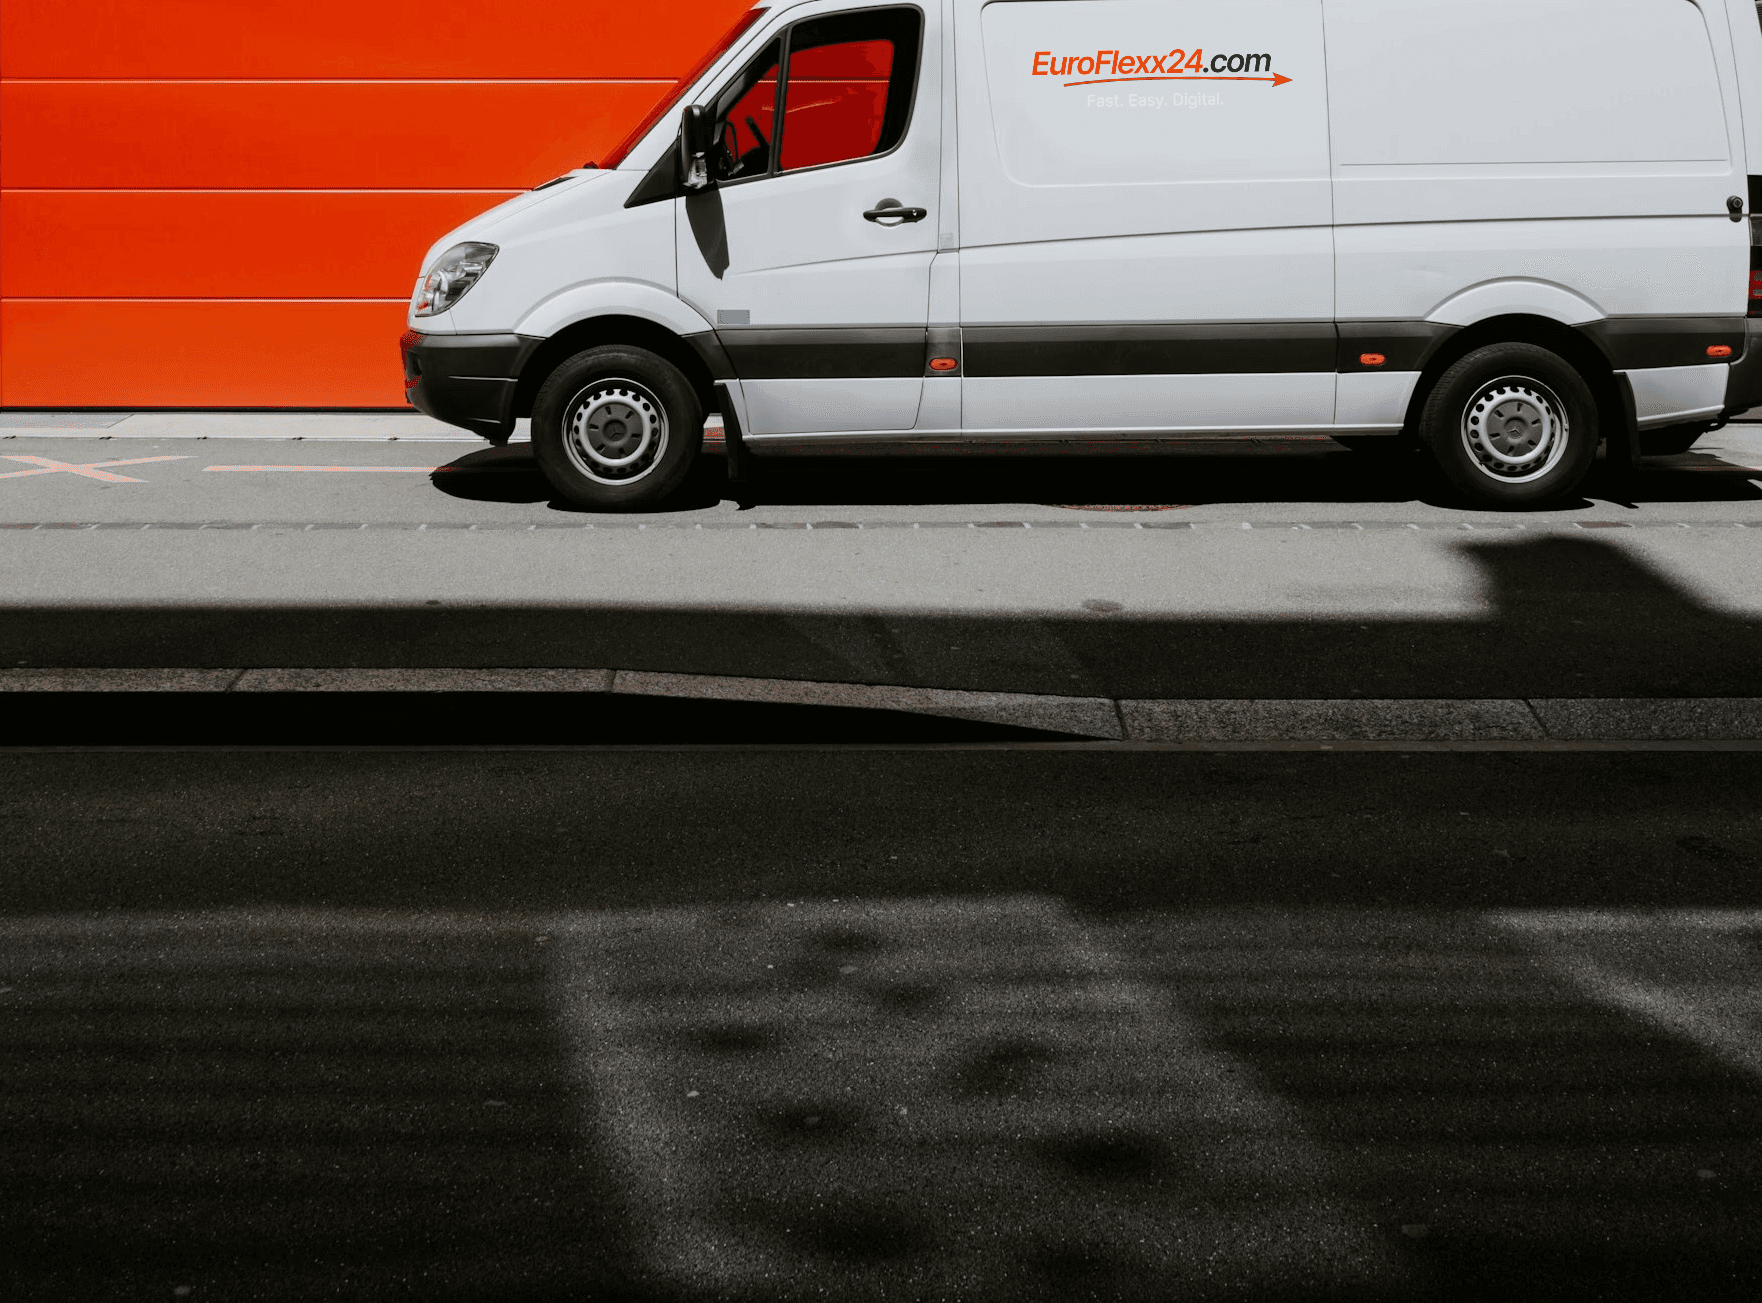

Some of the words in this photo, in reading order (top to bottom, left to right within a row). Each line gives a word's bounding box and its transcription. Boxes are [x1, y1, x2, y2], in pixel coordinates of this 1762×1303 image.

[1031, 48, 1272, 76] EuroFlexx24.com
[1086, 94, 1124, 108] Fast.
[1128, 93, 1168, 110] Easy.
[1173, 91, 1224, 110] Digital.
